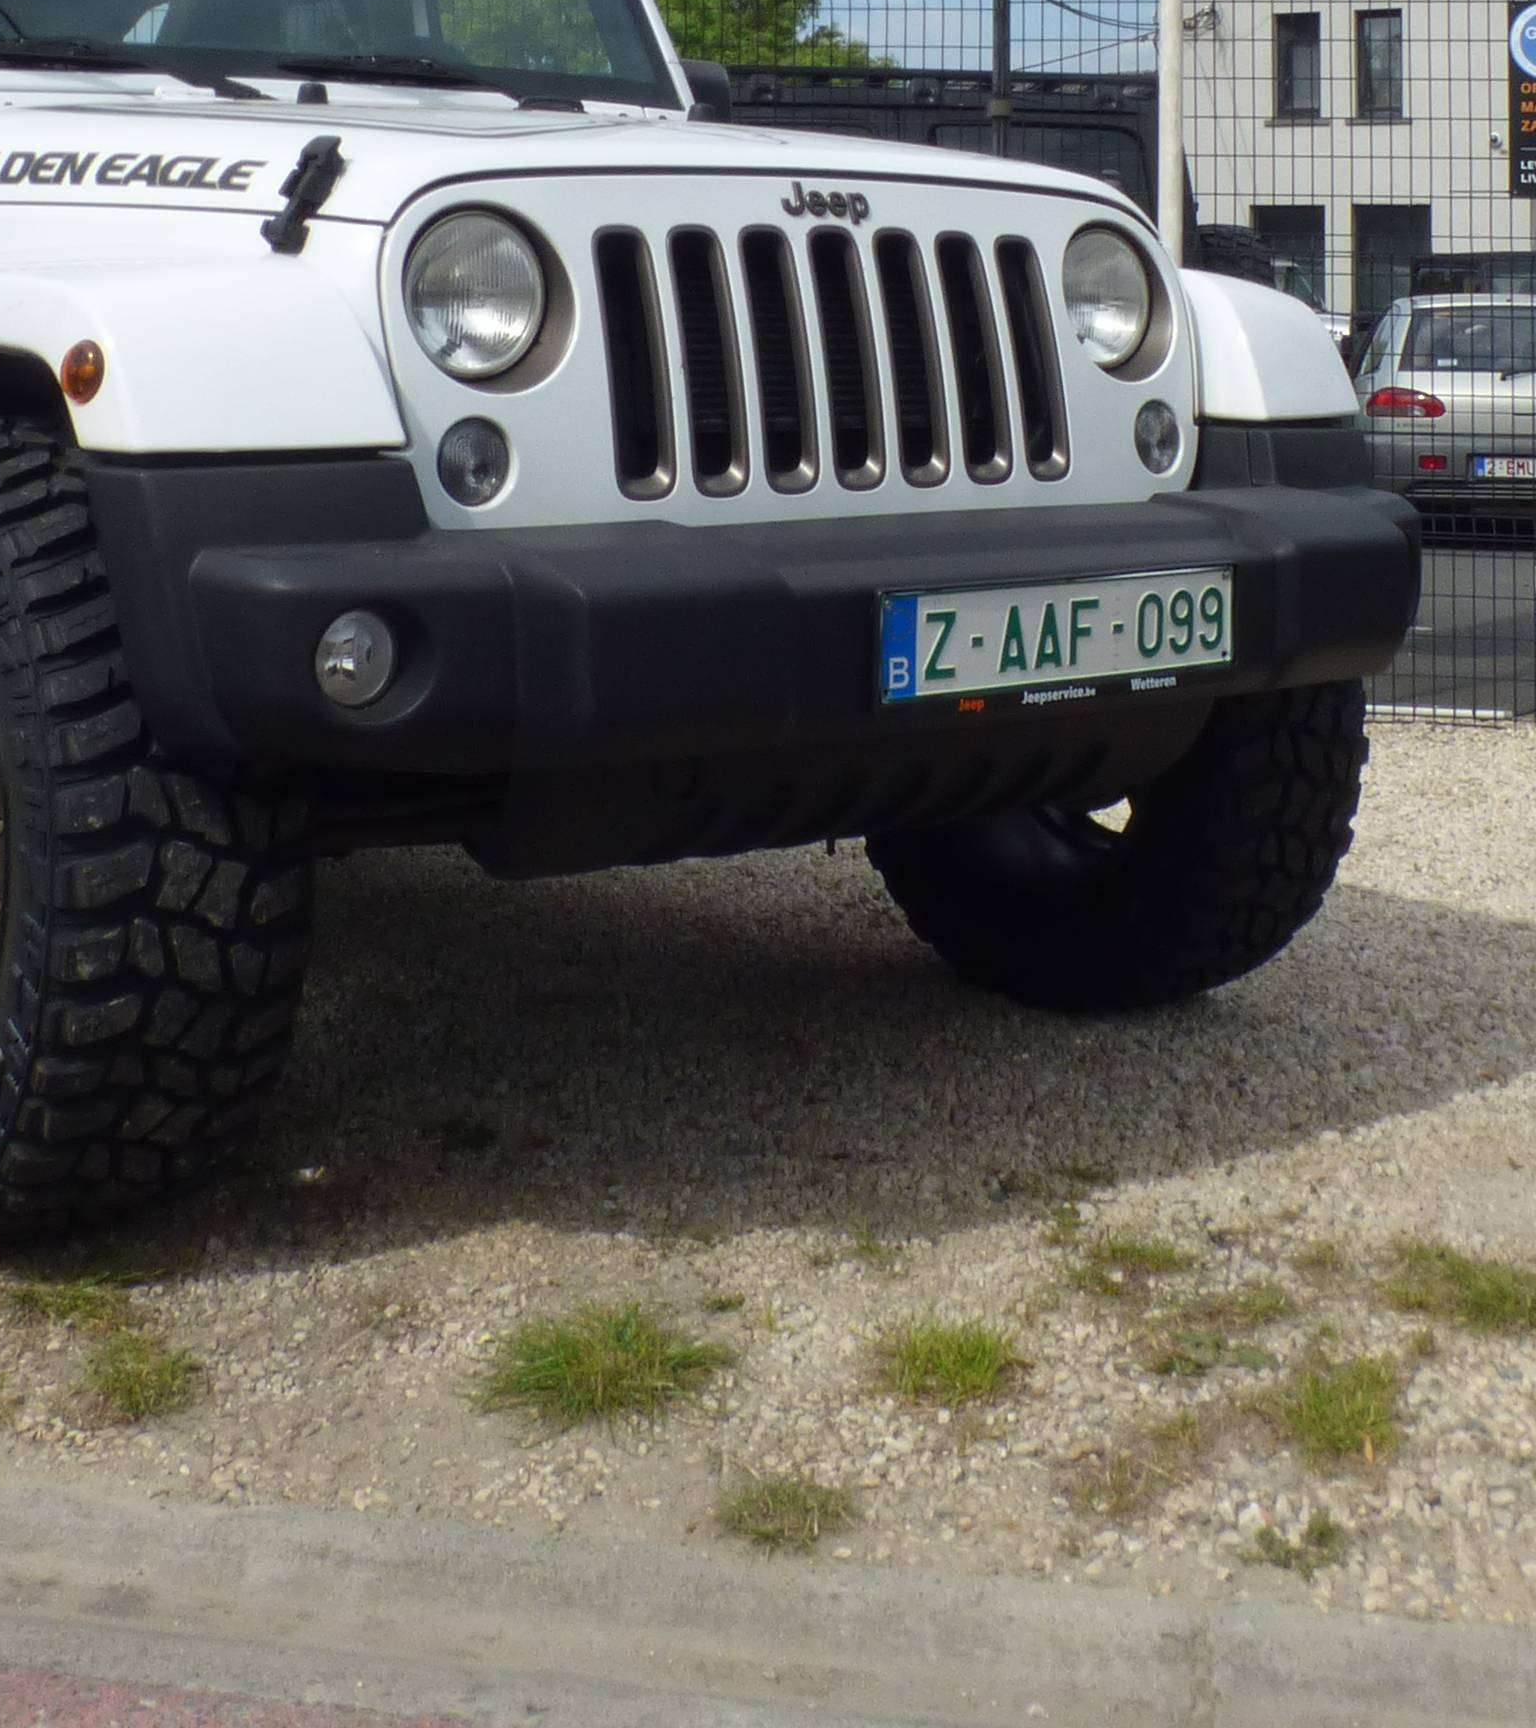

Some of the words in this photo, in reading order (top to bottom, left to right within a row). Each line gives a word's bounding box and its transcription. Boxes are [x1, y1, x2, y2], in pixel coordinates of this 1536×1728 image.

[94, 152, 270, 193] EAGLE
[780, 180, 870, 226] Jeep
[888, 656, 910, 689] B
[923, 585, 1225, 682] Z-AAF-099
[1021, 685, 1097, 705] Jeepservice.be
